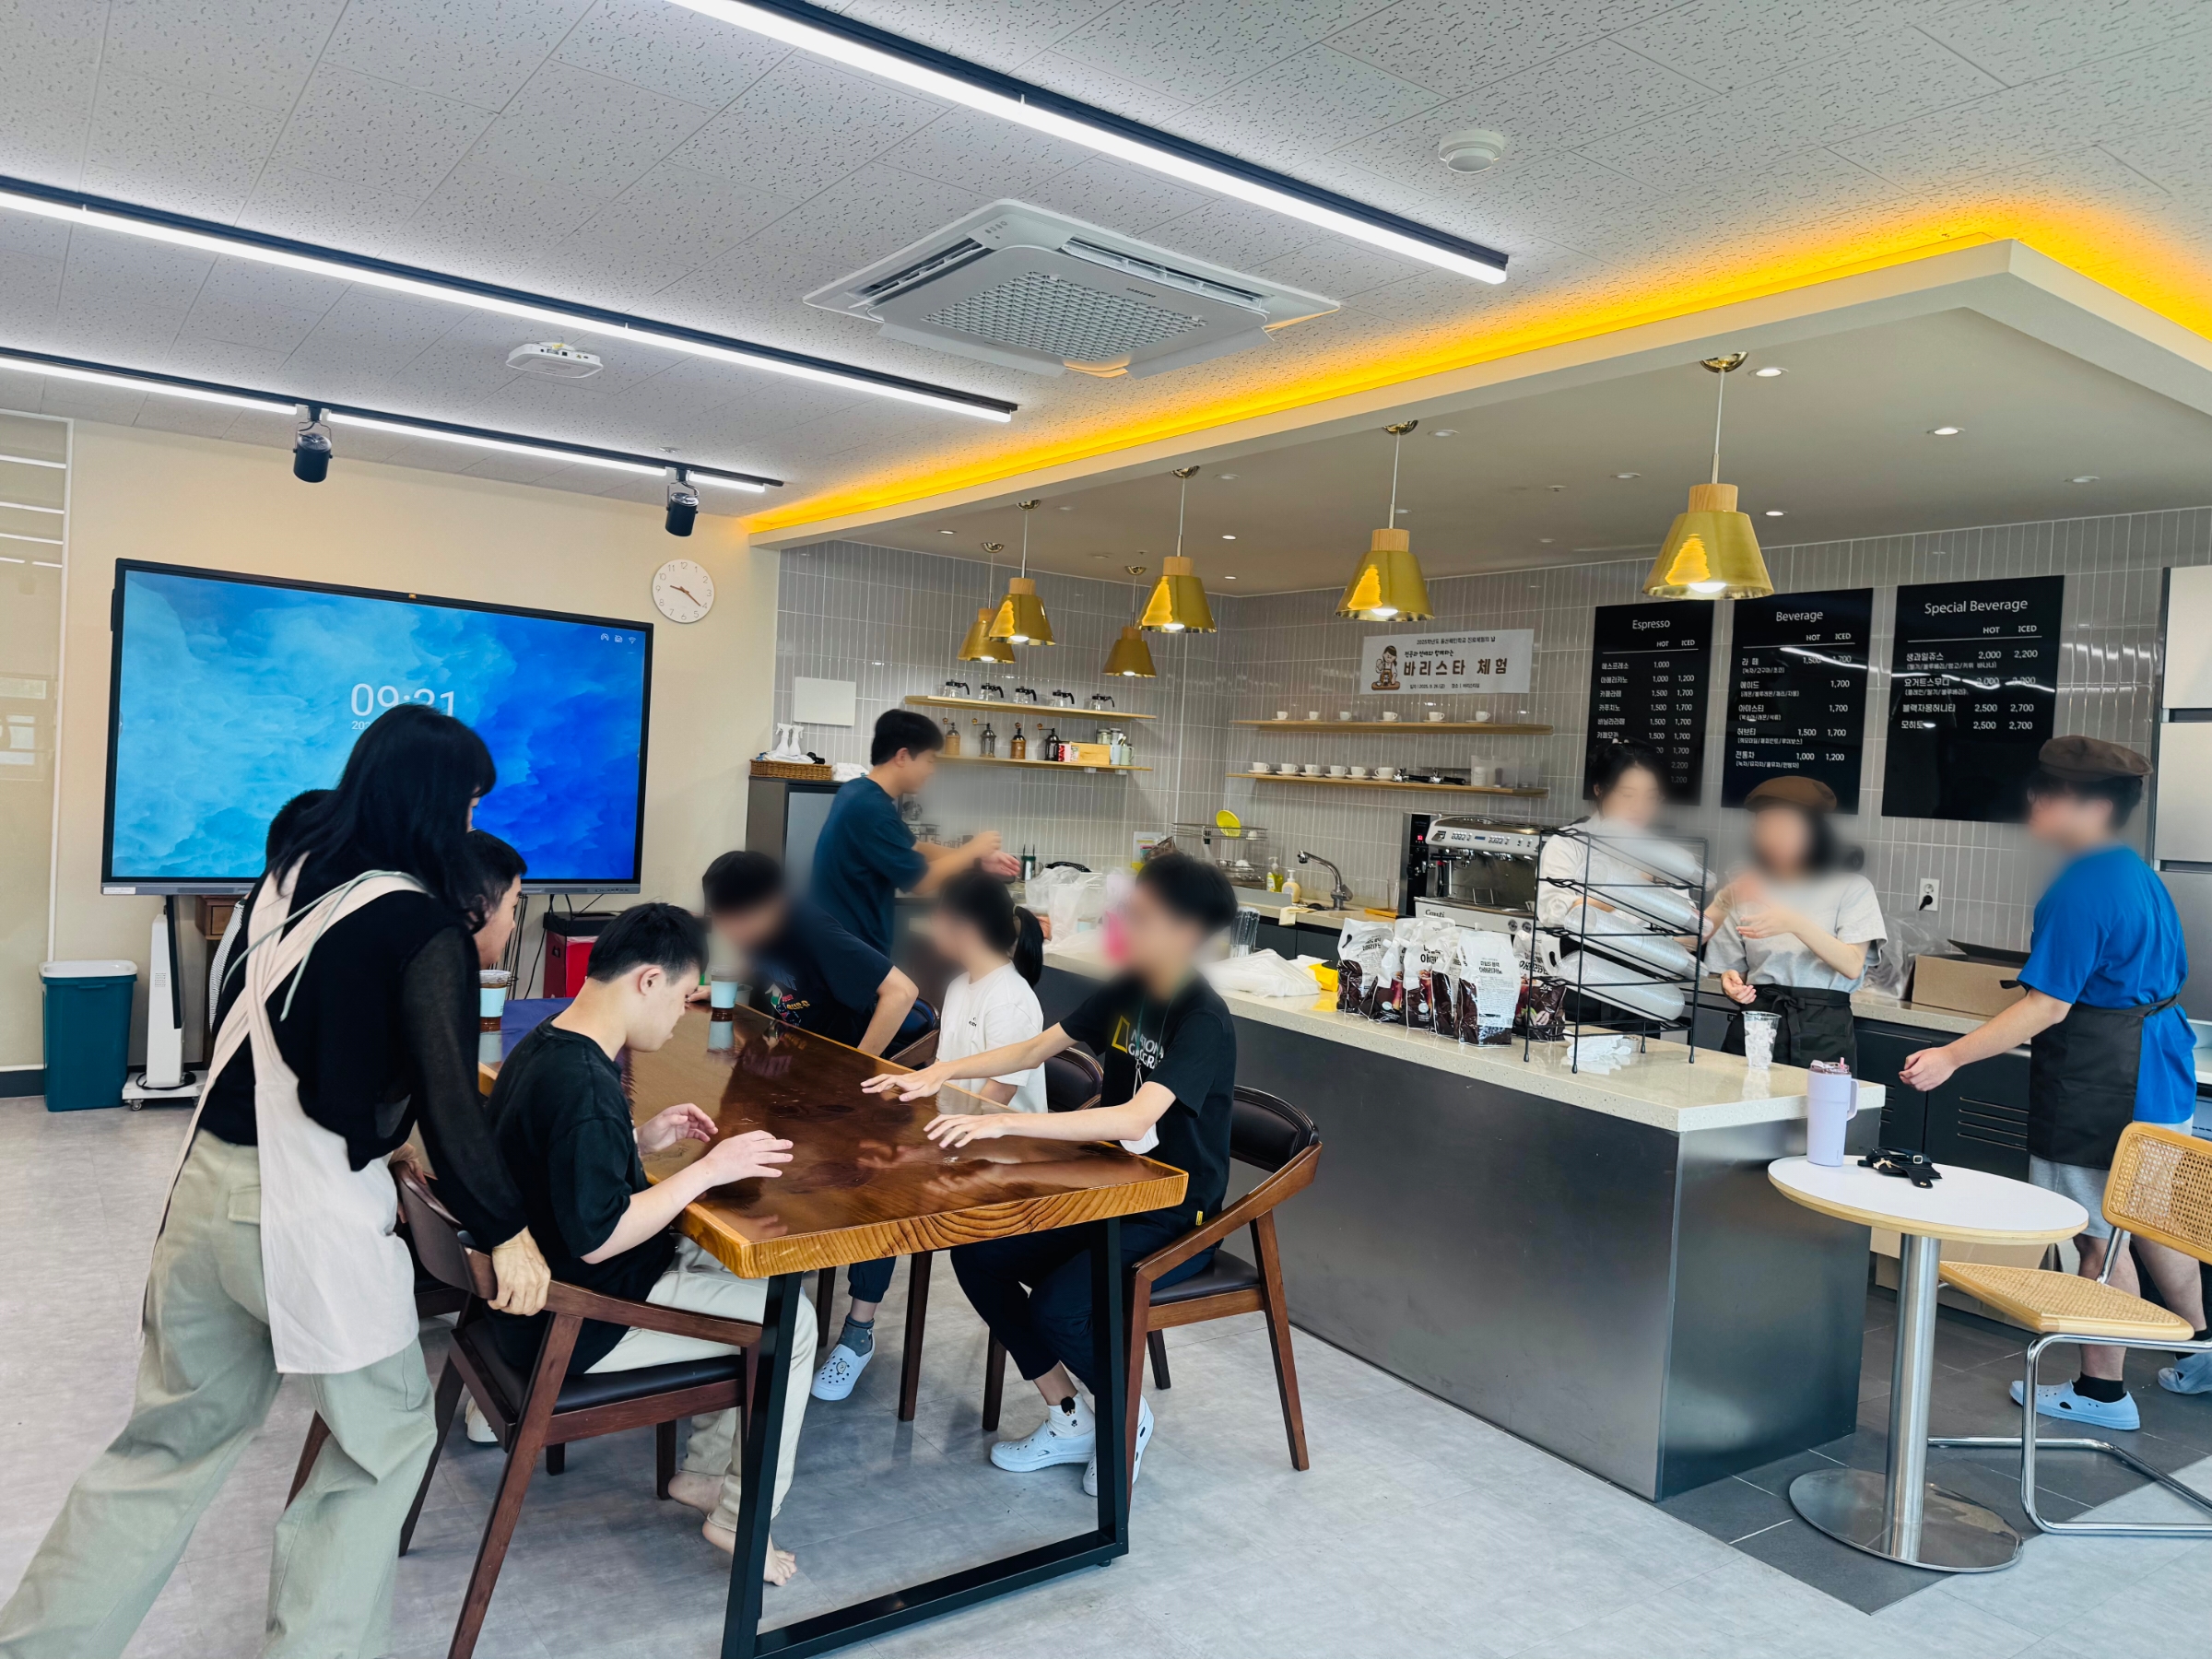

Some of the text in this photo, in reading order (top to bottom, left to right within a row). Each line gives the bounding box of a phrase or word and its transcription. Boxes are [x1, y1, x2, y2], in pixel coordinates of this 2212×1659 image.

[702, 575, 708, 584] 2
[655, 584, 662, 593] 9
[706, 588, 712, 597] 3
[1924, 600, 2028, 616] Special Beverage
[693, 610, 700, 618] 5
[1776, 611, 1823, 623] Beverage
[1632, 619, 1670, 630] Espresso
[1978, 651, 2002, 660] 2,000
[2014, 650, 2038, 658] 2,200
[1803, 656, 1821, 665] 1,500
[1404, 658, 1508, 676] 바리스타 체험
[1602, 662, 1629, 670] 에스프레소
[1740, 681, 1759, 689] 에이드
[1904, 677, 1950, 687] 요거트스무디
[1738, 704, 1848, 712] 아이스티 1,700
[1902, 704, 2034, 712] 블랙자몽허니티 2,500 2,700
[1901, 721, 2033, 730] 모히토 2,500 2,700
[1798, 728, 1817, 736] 1,500
[1735, 750, 1844, 761] 전통차 1,000 1,200
